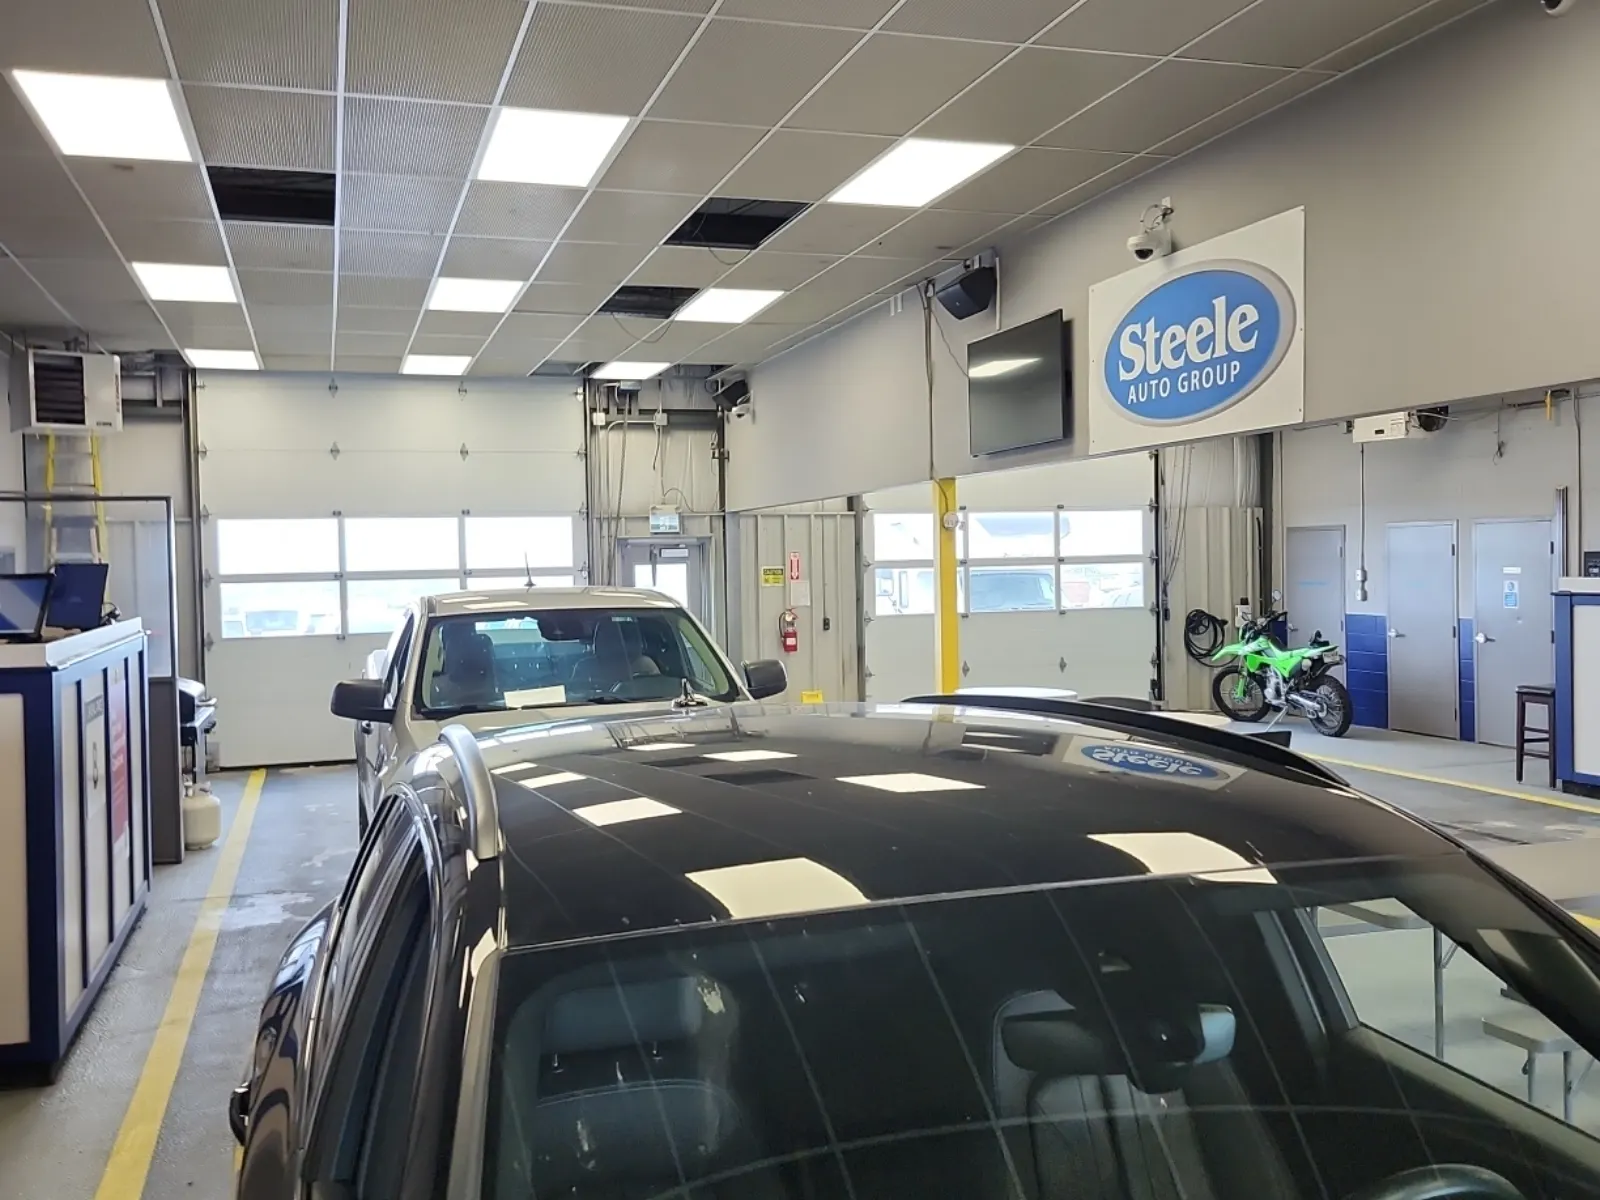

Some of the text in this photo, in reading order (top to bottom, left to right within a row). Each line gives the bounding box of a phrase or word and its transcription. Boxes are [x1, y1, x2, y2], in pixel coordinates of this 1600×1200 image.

[1118, 295, 1260, 382] Steele
[1127, 360, 1241, 405] AUTO GROUP
